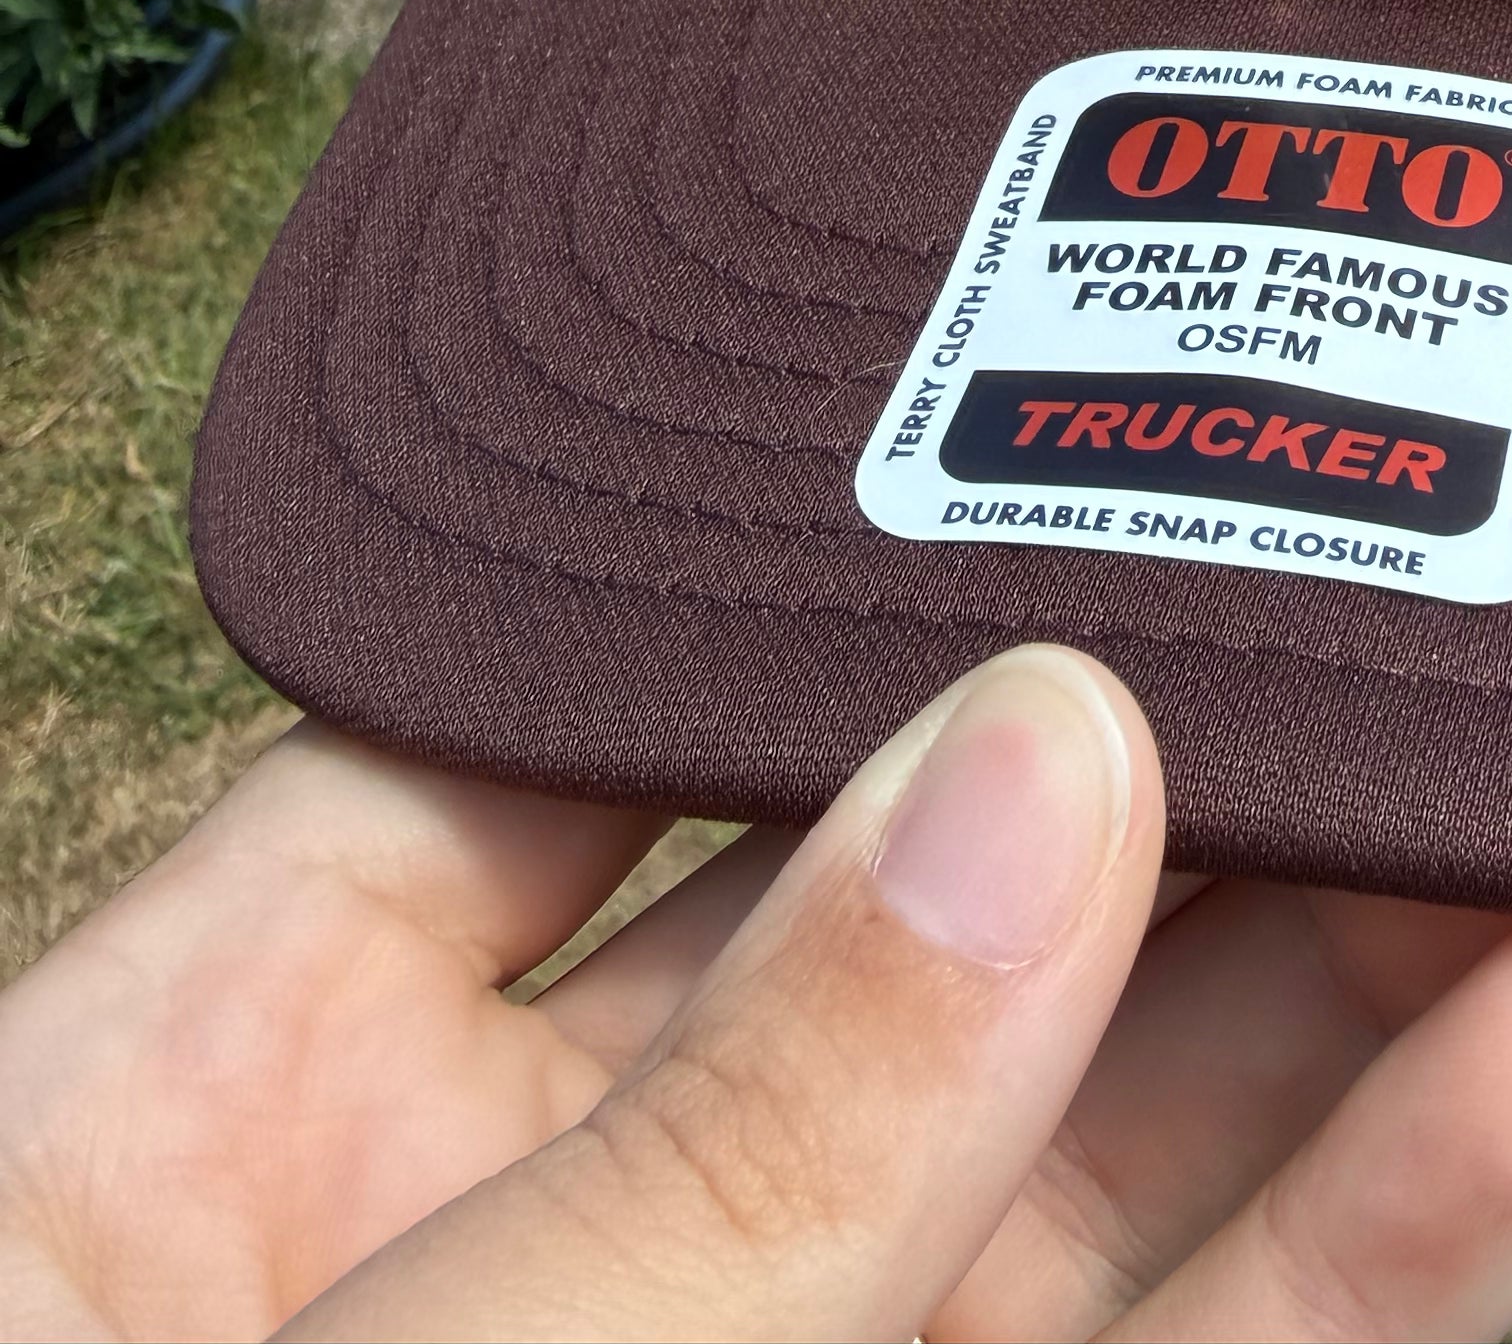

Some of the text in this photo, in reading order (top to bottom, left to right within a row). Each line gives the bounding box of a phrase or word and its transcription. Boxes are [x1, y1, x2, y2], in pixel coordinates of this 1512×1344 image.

[1134, 64, 1285, 89] PREMIUM
[1295, 71, 1393, 100] FOAM
[884, 113, 1058, 463] TERRY CLOTH SWEATBAND
[1046, 241, 1510, 318] WORLD FAMOUS
[1070, 280, 1460, 347] FOAM FRONT
[1176, 322, 1323, 366] OSFM
[1015, 400, 1447, 494] TRUCKER
[939, 500, 1427, 577] DURABLE SNAP CLOSURE
